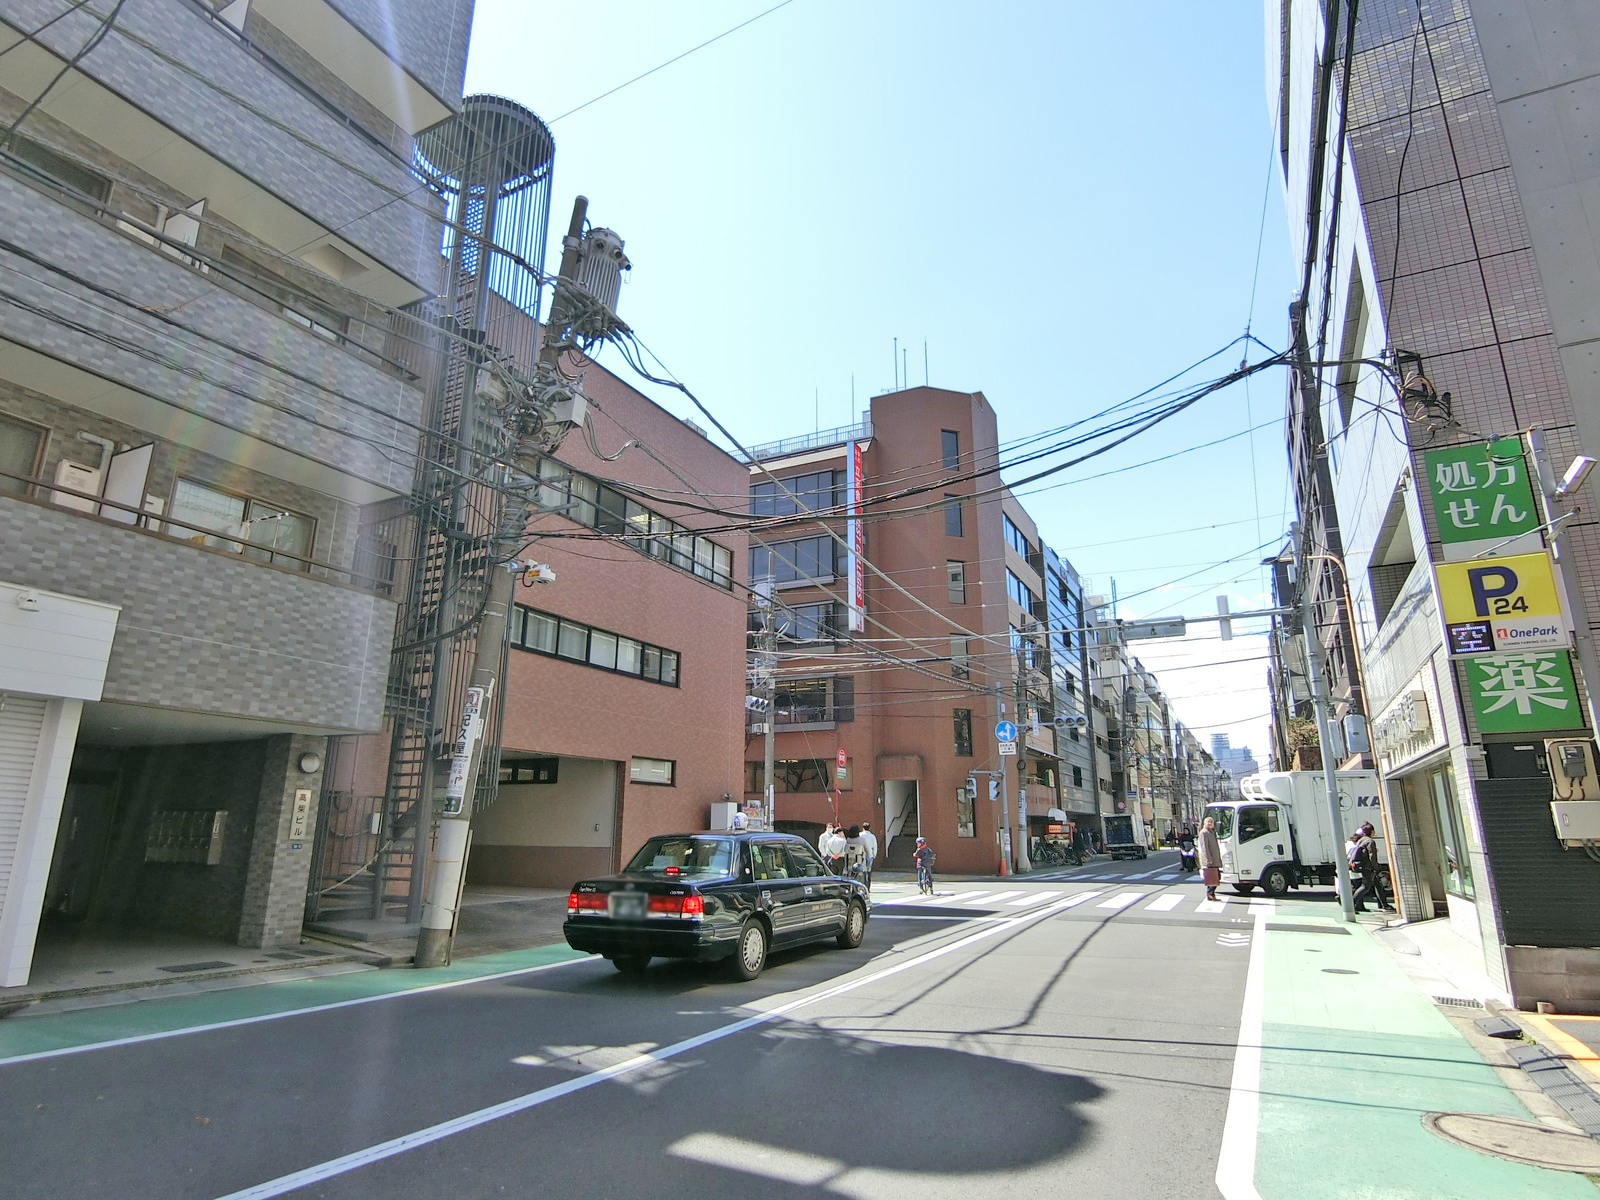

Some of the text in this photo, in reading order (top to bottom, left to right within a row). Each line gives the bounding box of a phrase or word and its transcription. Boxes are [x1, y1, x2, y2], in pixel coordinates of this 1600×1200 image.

[1435, 457, 1517, 494] 処方
[1443, 494, 1527, 528] せん
[1467, 565, 1529, 617] P 24
[1451, 623, 1491, 653] 空
[1509, 625, 1558, 639] OnePark
[1474, 652, 1569, 715] 薬
